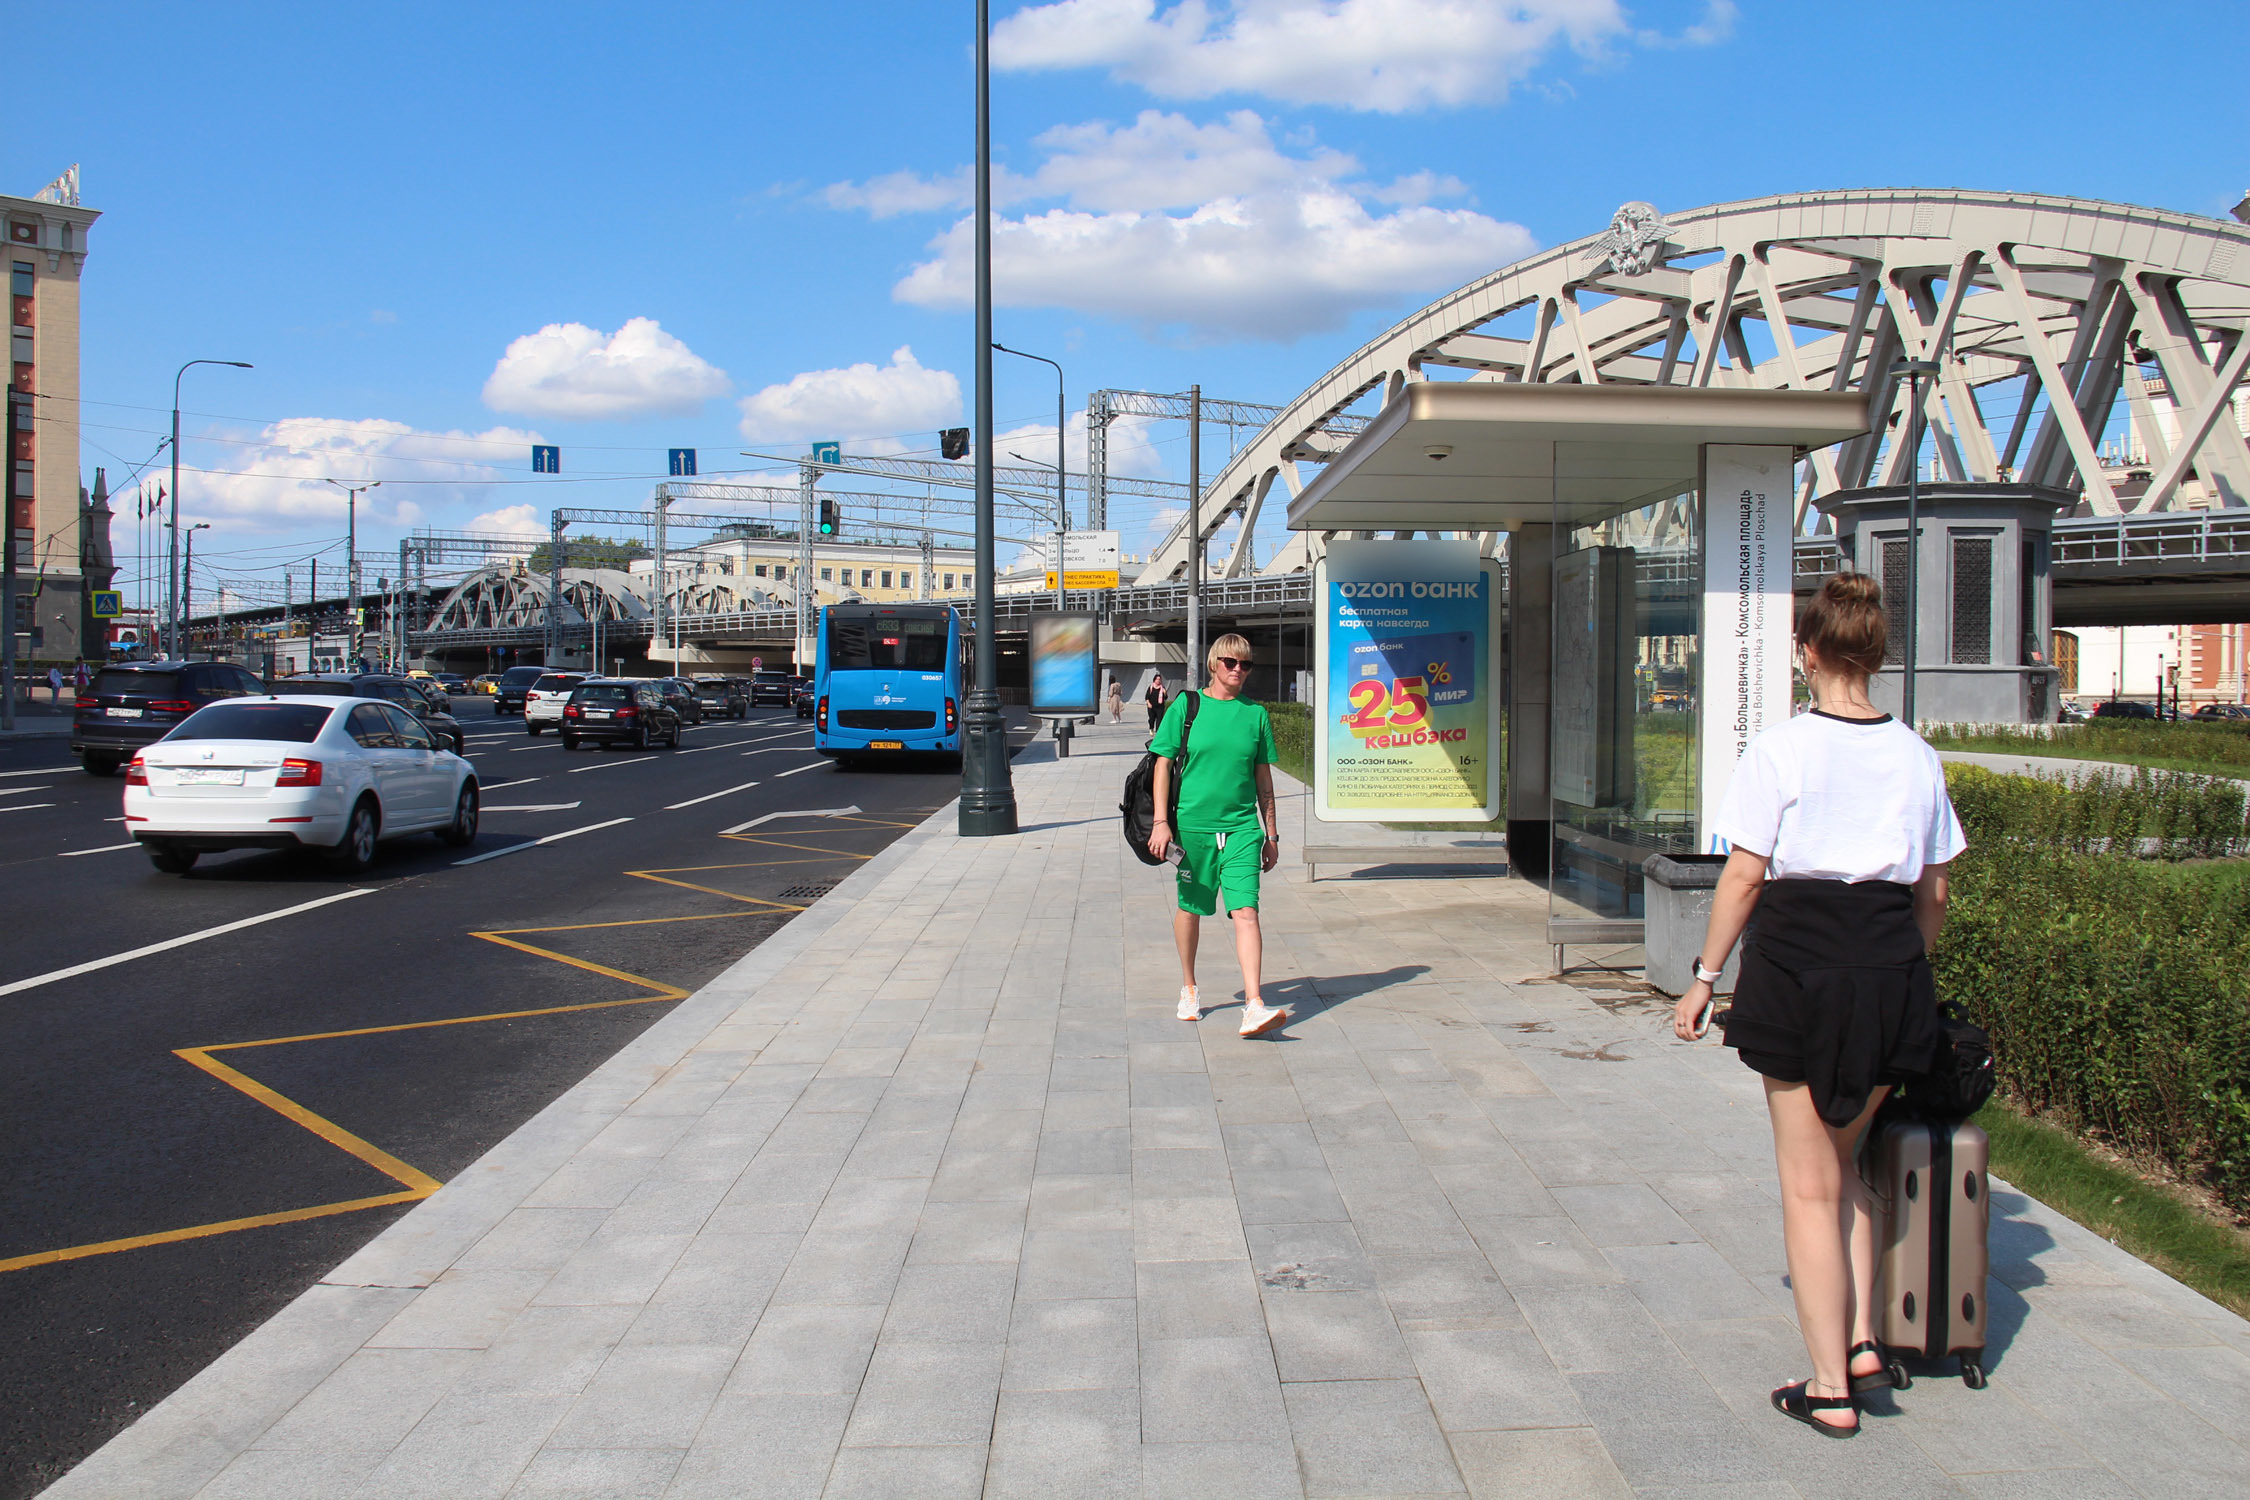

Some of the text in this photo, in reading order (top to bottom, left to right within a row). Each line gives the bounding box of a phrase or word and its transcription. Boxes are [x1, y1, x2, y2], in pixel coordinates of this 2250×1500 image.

[1739, 489, 1753, 540] площадь
[1755, 493, 1766, 541] Ploschad
[1340, 581, 1479, 598] ozon банк
[1736, 543, 1751, 638] Комсомольская
[1754, 544, 1766, 630] Komsomolskaya
[1339, 605, 1408, 616] бесплатная
[1339, 618, 1430, 629] карта навсегда
[1354, 642, 1404, 654] ozon банк
[1753, 639, 1764, 709] Bolshevichka
[1434, 690, 1467, 701] МИР
[1734, 648, 1749, 738] «Большевичка»
[1340, 713, 1358, 724] до
[1365, 728, 1467, 749] кешбэка
[1459, 755, 1479, 766] 16+
